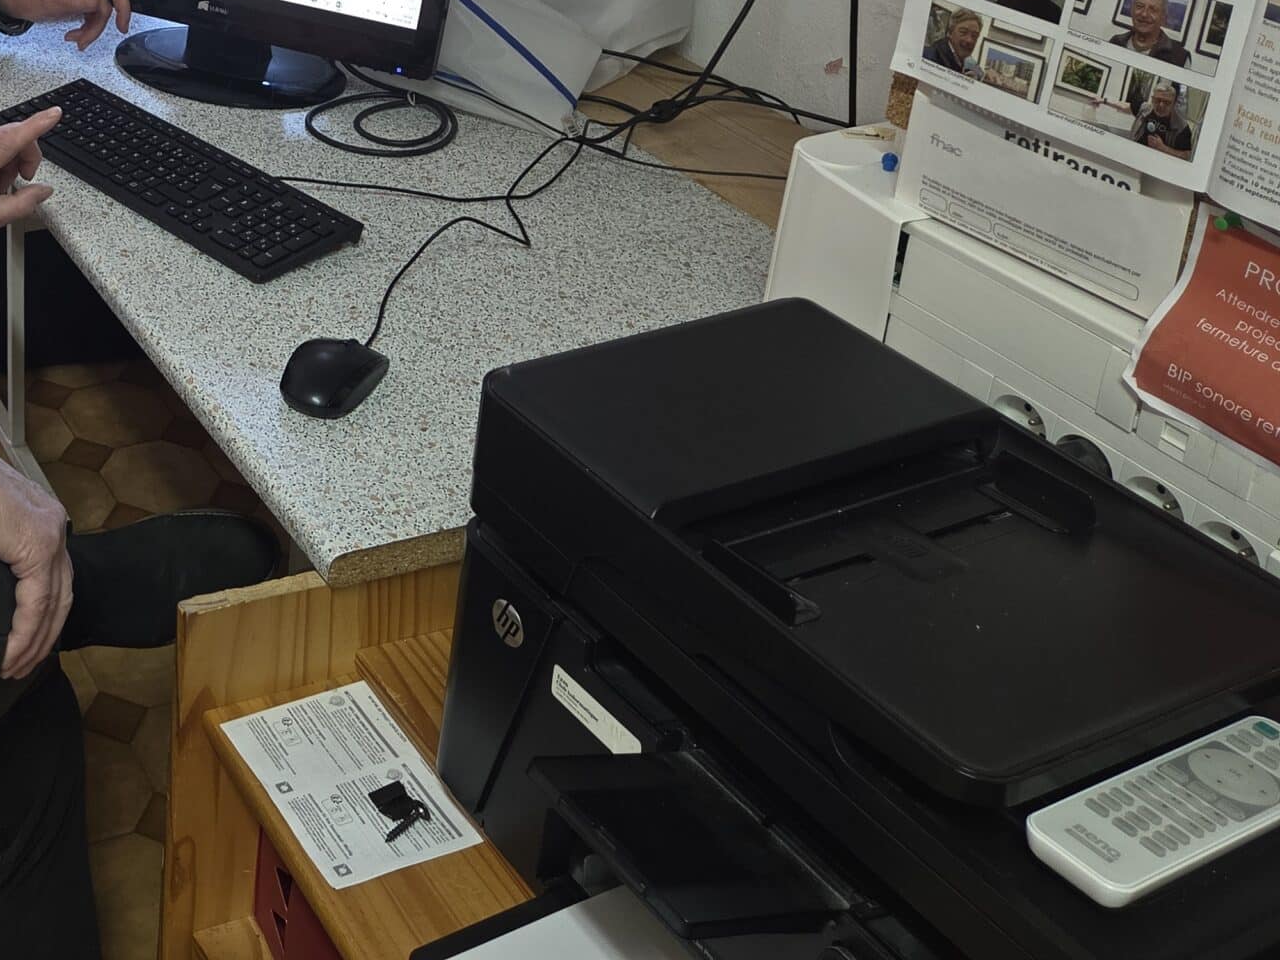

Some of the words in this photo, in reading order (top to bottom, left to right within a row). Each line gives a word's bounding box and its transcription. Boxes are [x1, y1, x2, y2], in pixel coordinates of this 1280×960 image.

[1237, 104, 1273, 128] Vacances
[930, 133, 963, 157] fnac
[1244, 261, 1280, 295] PR
[1216, 289, 1280, 328] Attendre
[1196, 317, 1269, 363] fermeture
[1167, 363, 1193, 383] BIP
[1195, 382, 1253, 422] sonore
[496, 602, 521, 640] hp
